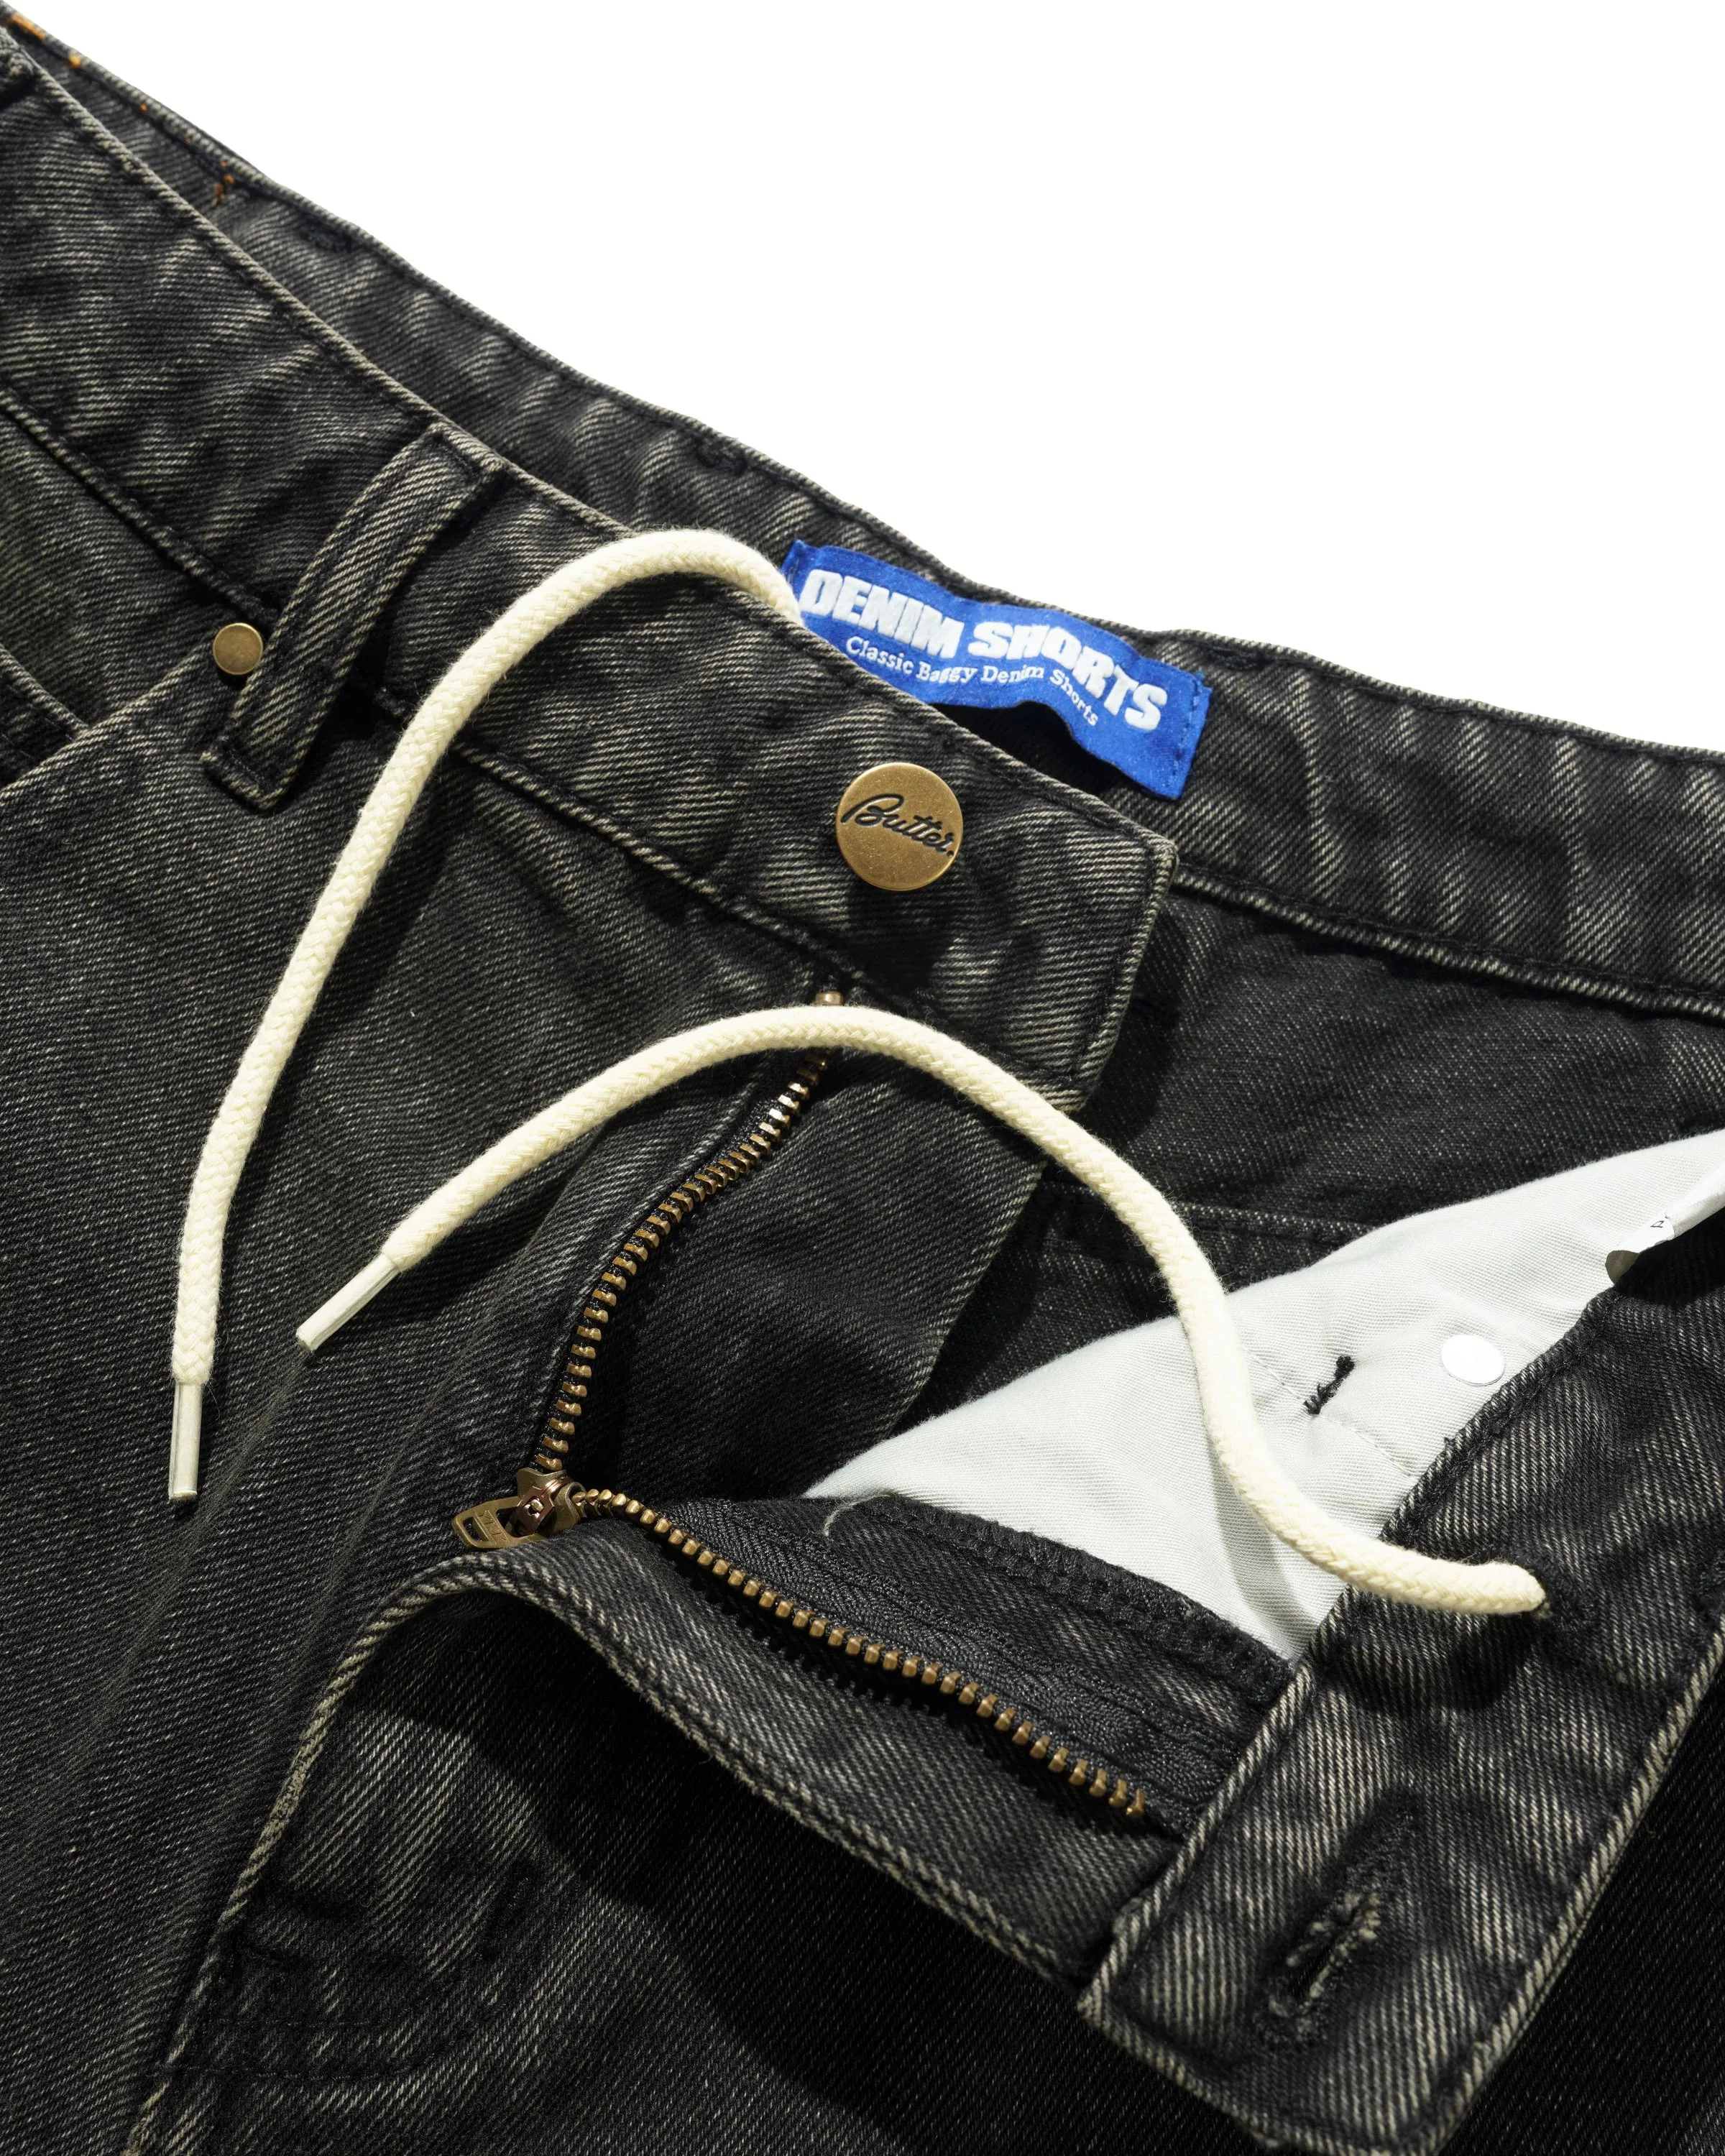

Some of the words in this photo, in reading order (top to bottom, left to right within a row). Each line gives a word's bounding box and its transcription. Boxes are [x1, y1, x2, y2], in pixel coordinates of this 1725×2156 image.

[799, 569, 964, 658] DENIM
[968, 621, 1169, 731] SHORTS
[846, 635, 914, 675] Classic
[916, 660, 978, 683] Baggy
[980, 665, 1045, 683] Denim
[1049, 669, 1098, 727] Shorts
